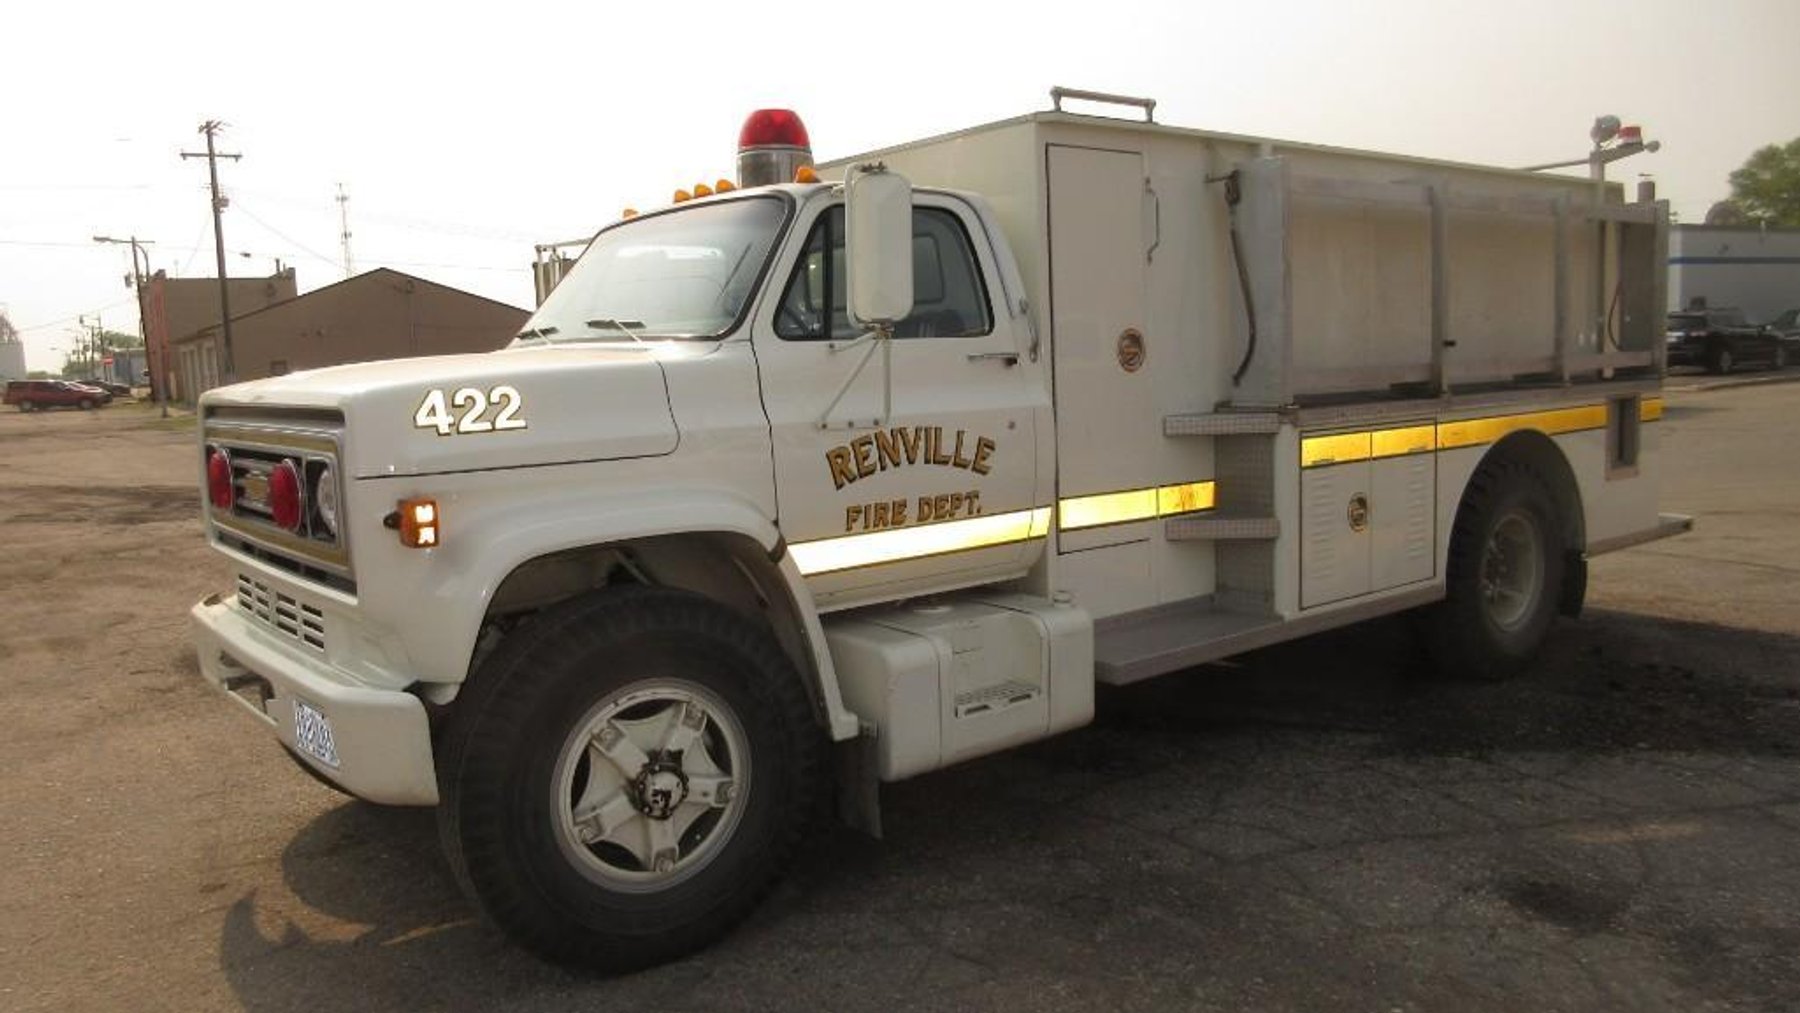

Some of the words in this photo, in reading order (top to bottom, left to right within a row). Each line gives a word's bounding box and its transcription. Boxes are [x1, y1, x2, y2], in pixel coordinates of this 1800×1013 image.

[413, 385, 528, 436] 422
[826, 426, 996, 490] RENVILLE
[846, 499, 907, 532] FIRE
[917, 490, 982, 522] DEPT.
